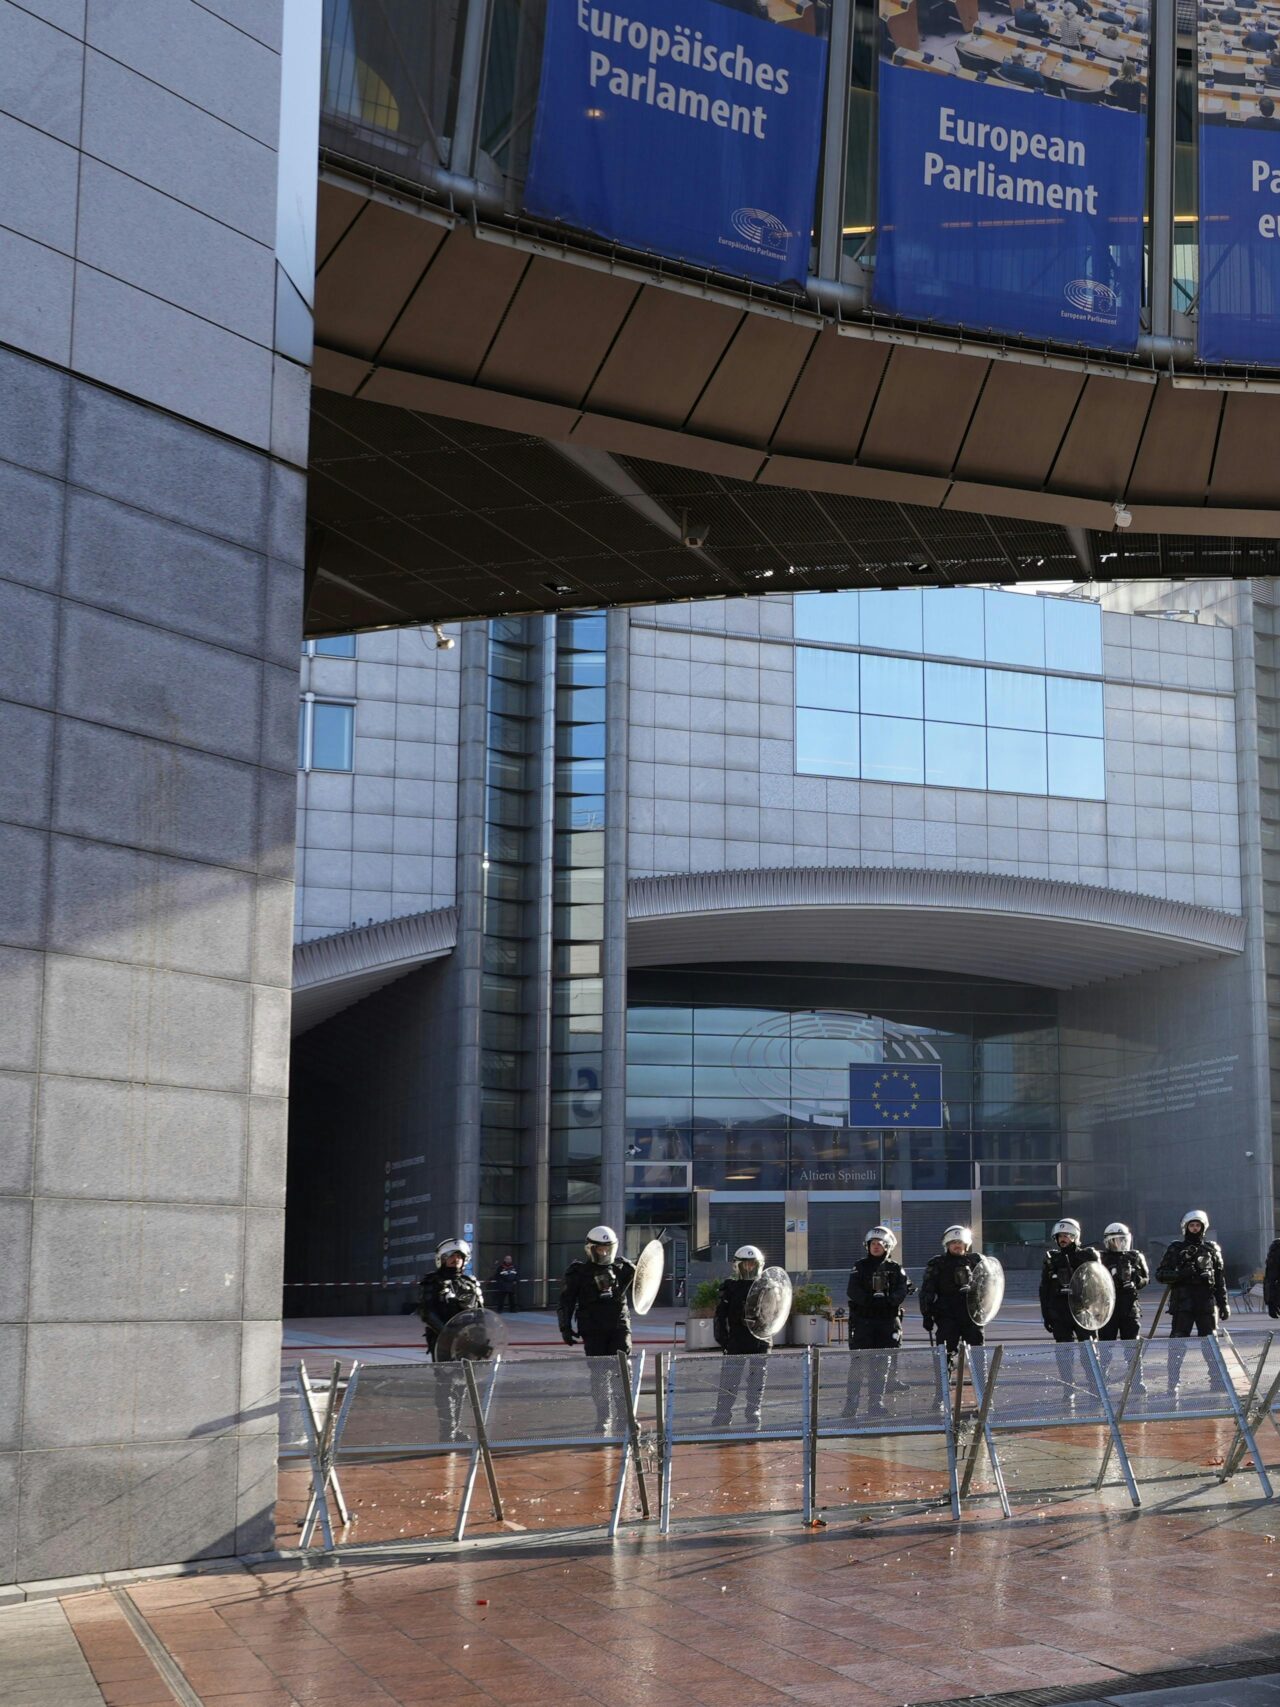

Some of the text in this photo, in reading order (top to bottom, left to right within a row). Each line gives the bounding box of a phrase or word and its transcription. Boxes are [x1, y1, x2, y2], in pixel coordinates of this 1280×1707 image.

[577, 0, 789, 95] Europäisches
[590, 50, 767, 140] Parlament
[939, 106, 1086, 167] European
[924, 151, 1099, 216] Parliament
[718, 236, 788, 261] Europäisches Parlament
[1060, 310, 1118, 326] European Parliament
[800, 1169, 877, 1183] Altiero Spinelli
